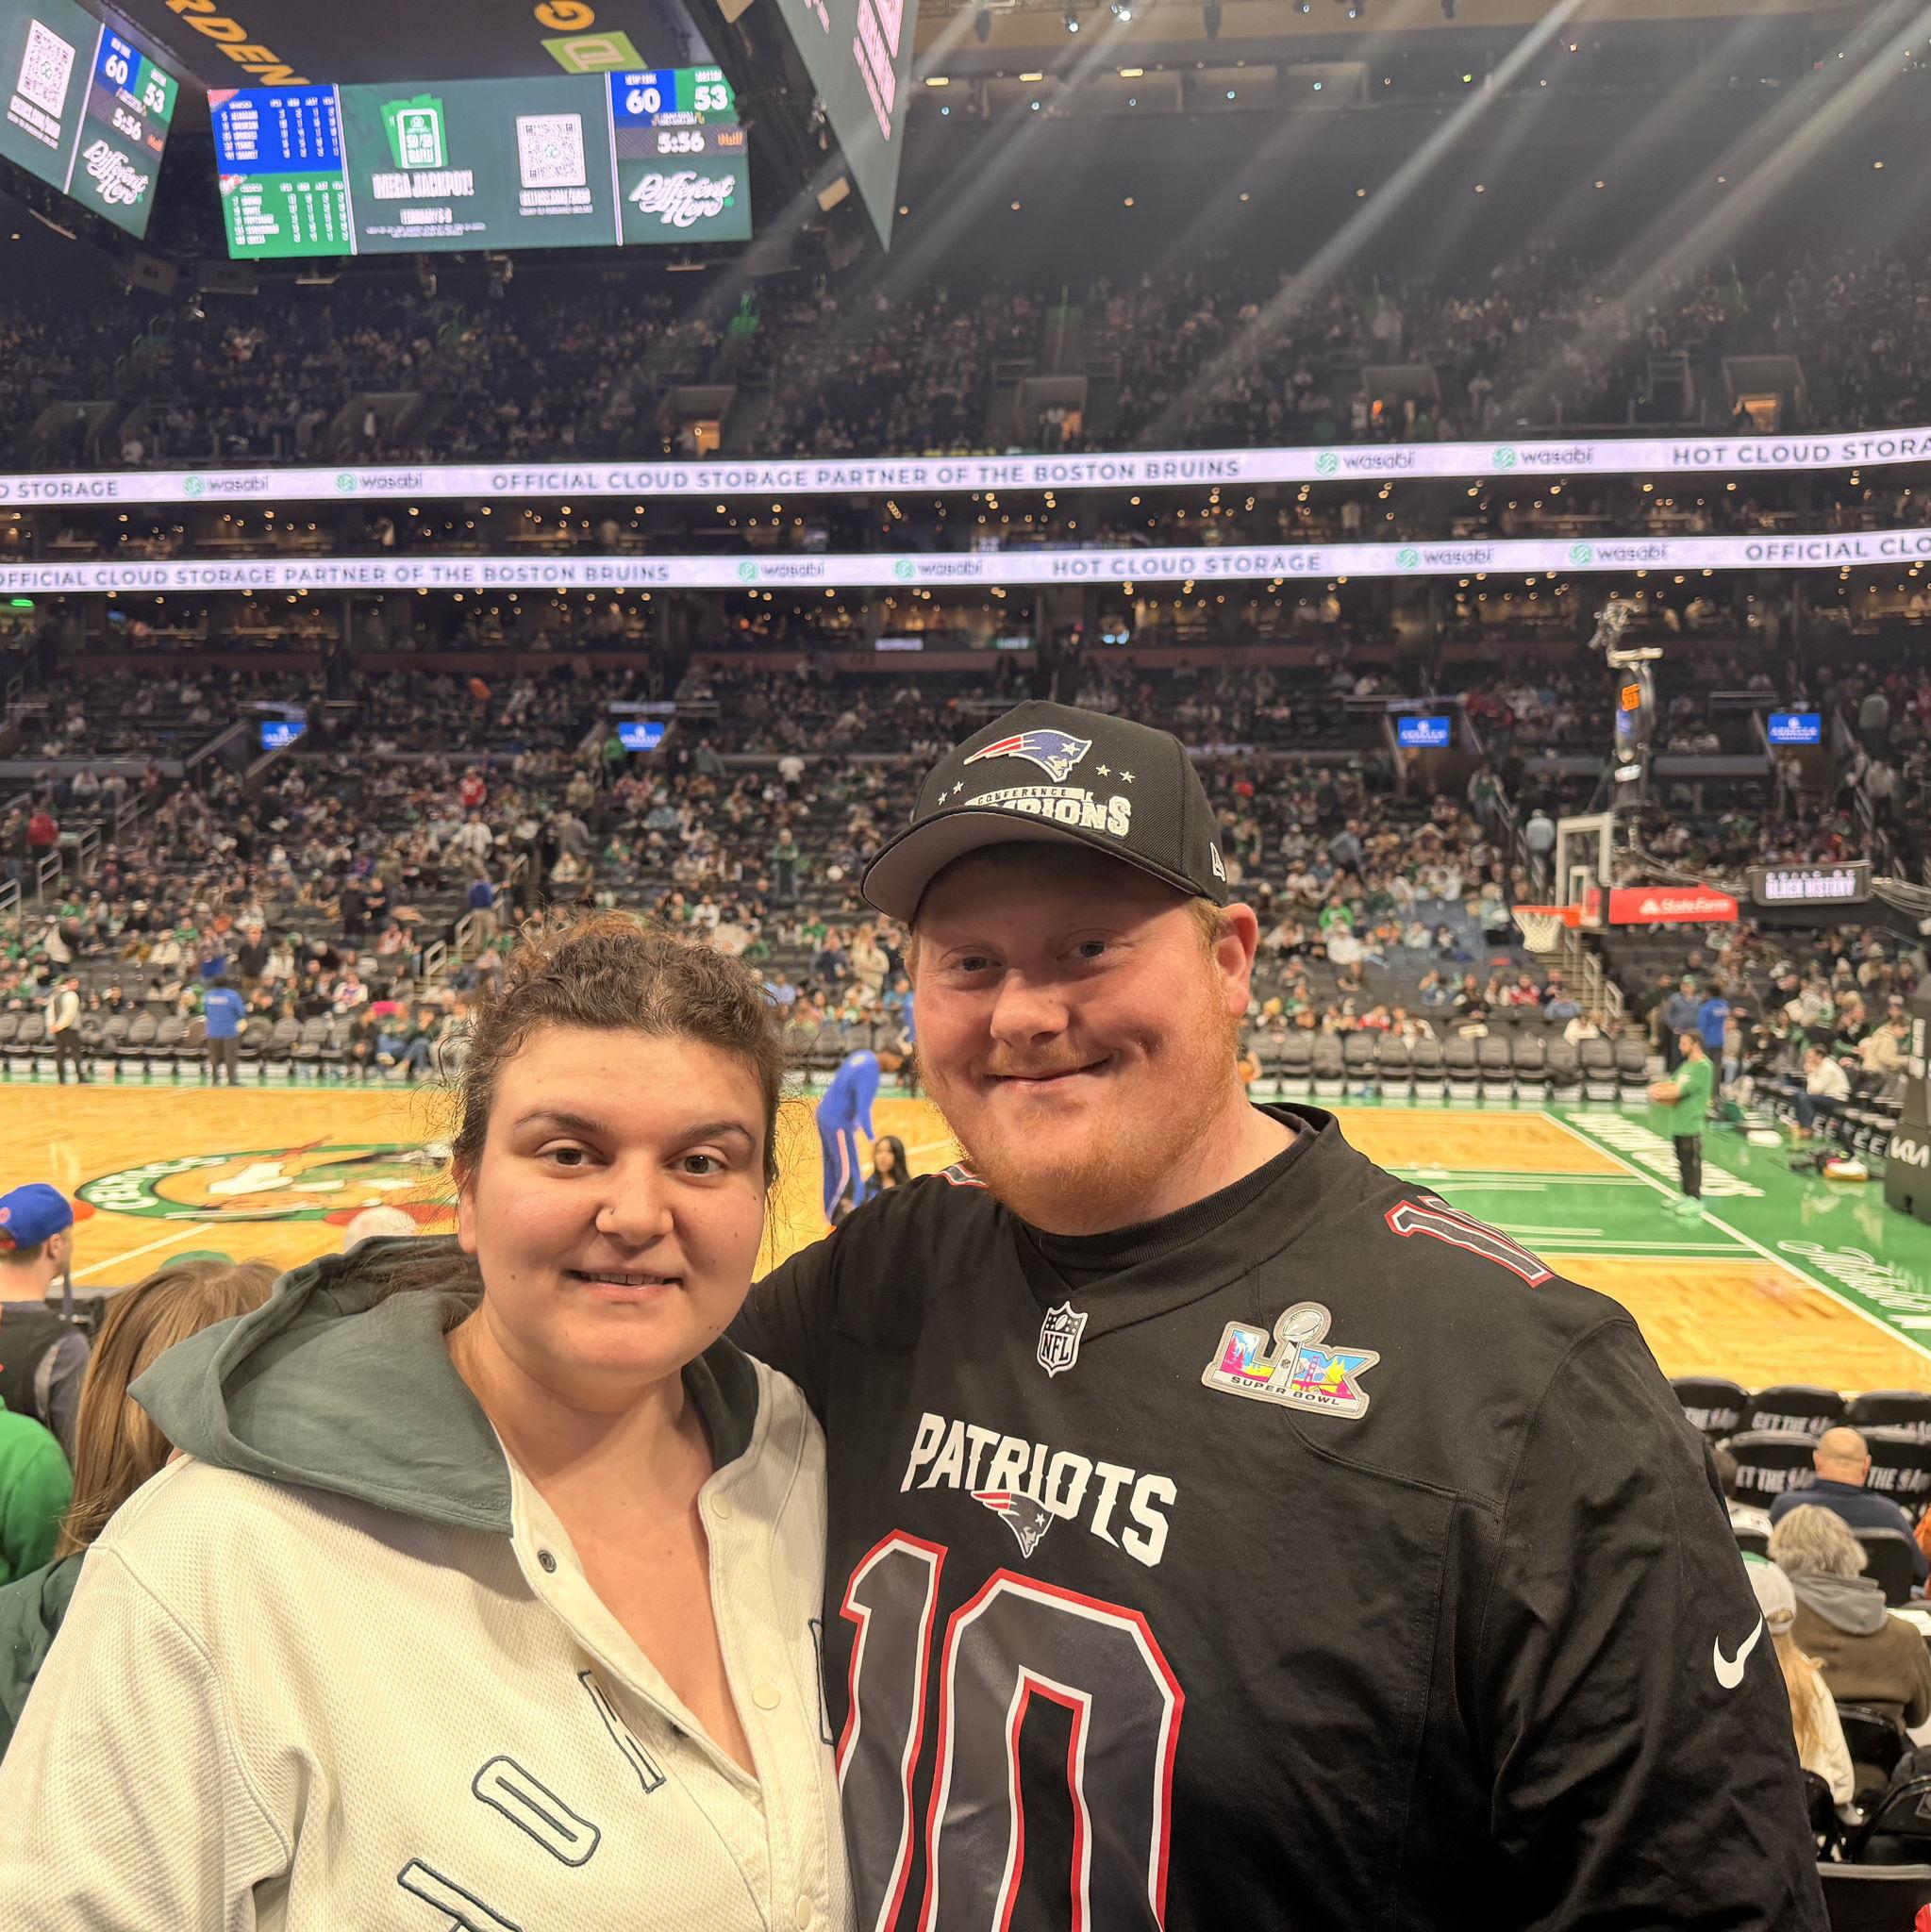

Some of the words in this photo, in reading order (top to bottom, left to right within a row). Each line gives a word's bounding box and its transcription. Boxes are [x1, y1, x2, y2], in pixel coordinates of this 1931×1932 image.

[106, 54, 128, 85] 60
[626, 88, 661, 114] 60
[694, 85, 728, 111] 53
[658, 130, 705, 154] 5:56
[629, 171, 735, 206] Different
[1343, 451, 1415, 470] wasabi
[1522, 446, 1593, 465] wasabi
[1673, 447, 1728, 465] HOT
[1738, 444, 1830, 463] CLOUD
[209, 475, 270, 491] wasabi
[360, 472, 423, 489] wasabi
[492, 473, 599, 490] OFFICIAL
[608, 472, 688, 489] CLOUD
[696, 470, 808, 488] STORAGE
[818, 468, 927, 486] PARTNER
[937, 467, 968, 484] OF
[978, 464, 1025, 482] THE
[1035, 463, 1135, 481] BOSTON
[1146, 460, 1240, 479] BRUINS
[17, 480, 118, 498] STORAGE
[1423, 549, 1492, 566] wasabi
[1597, 544, 1668, 562] wasabi
[1746, 541, 1869, 560] OFFICIAL
[0, 570, 88, 587] FFICIAL
[96, 570, 168, 586] CLOUD
[176, 568, 275, 585] STORAGE
[285, 566, 385, 584] PARTNER
[395, 567, 424, 583] OF
[431, 566, 473, 582] THE
[484, 566, 574, 582] BOSTON
[586, 565, 670, 581] BRUINS
[1053, 559, 1101, 576] HOT
[1111, 558, 1194, 575] CLOUD
[1205, 554, 1322, 574] STORAGE
[977, 787, 1067, 806] CONFERENCE
[1041, 1333, 1070, 1364] NFL
[1230, 1376, 1287, 1394] SUPER
[1293, 1391, 1340, 1406] BOWL
[1736, 1465, 1756, 1488] ET
[900, 1411, 1177, 1568] PATRIOTS
[836, 1528, 1186, 1932] 10
